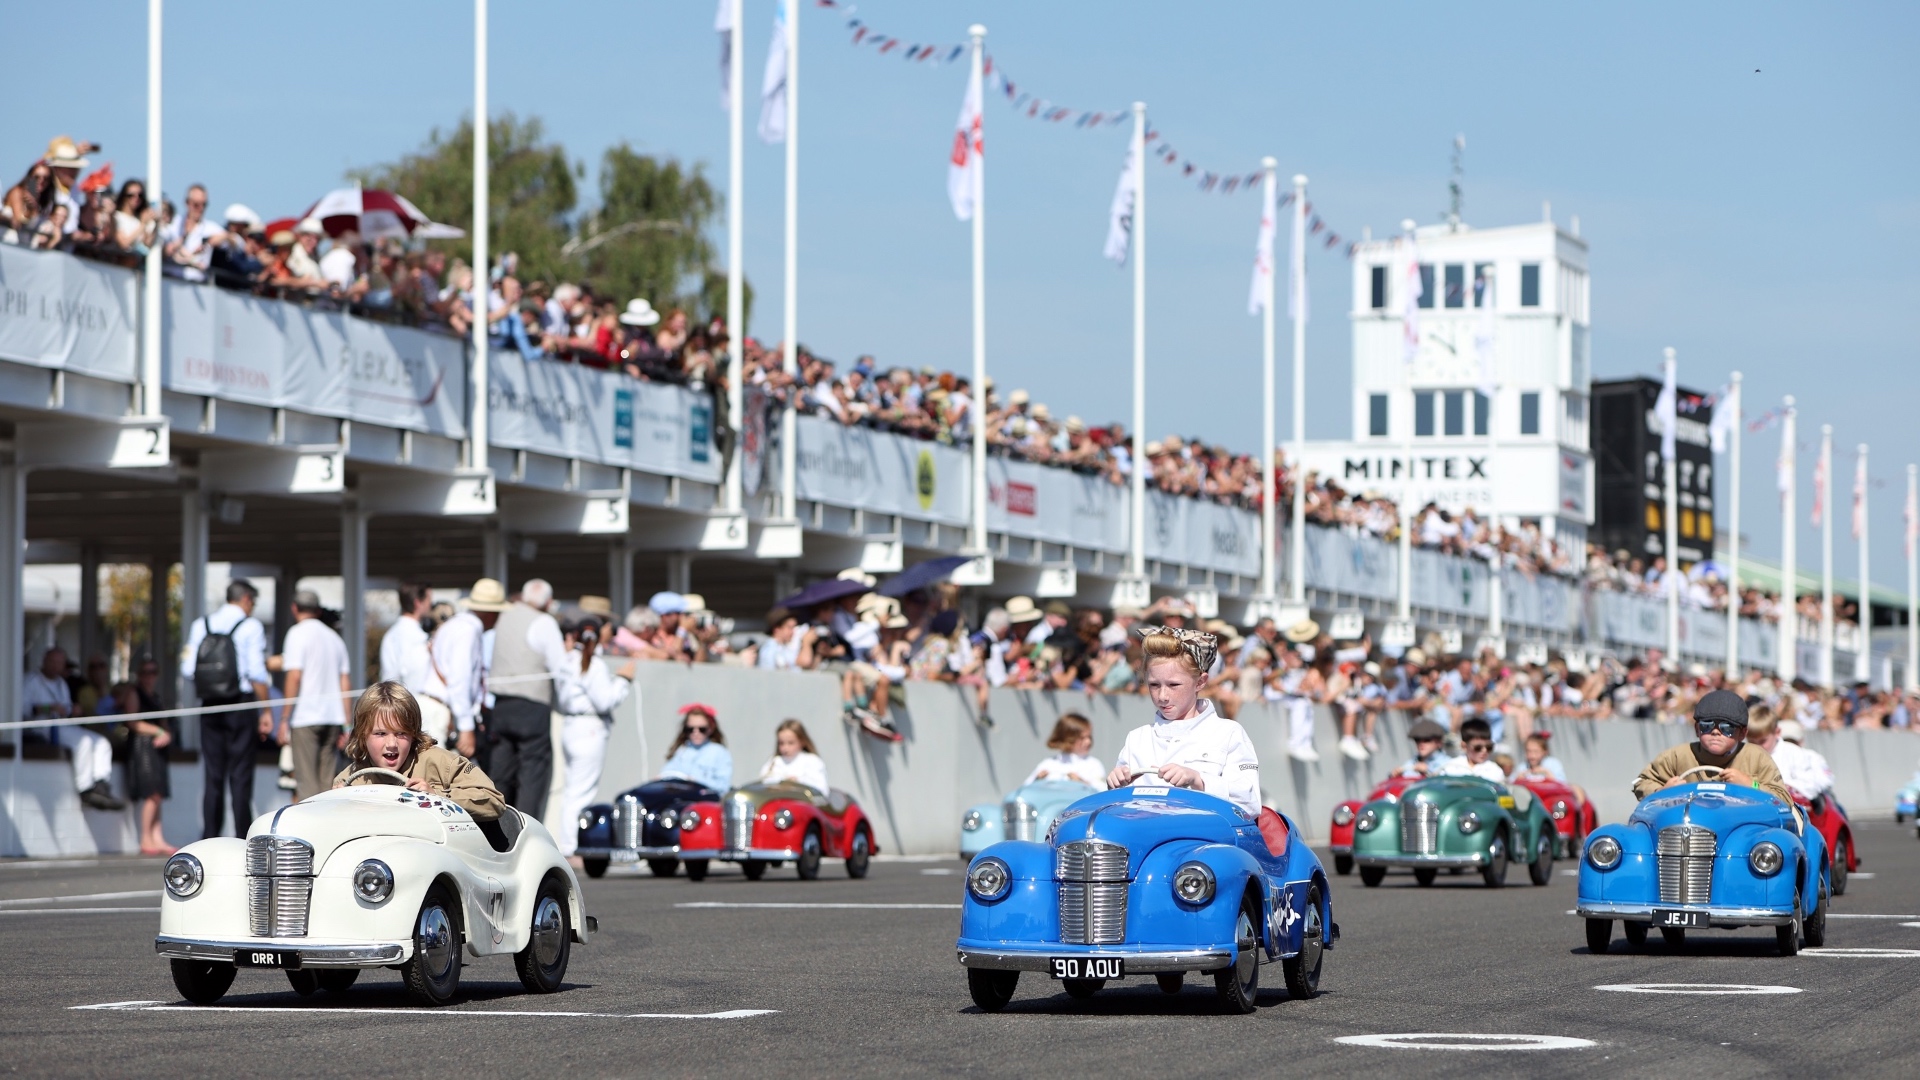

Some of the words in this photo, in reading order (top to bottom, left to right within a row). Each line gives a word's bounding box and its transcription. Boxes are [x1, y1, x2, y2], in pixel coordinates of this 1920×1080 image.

[146, 427, 161, 455] 2
[321, 455, 334, 482] 3
[1344, 456, 1486, 480] MINTEX
[473, 478, 486, 502] 4
[609, 498, 620, 522] 5
[726, 516, 740, 540] 6
[882, 540, 895, 562] 7
[1664, 912, 1689, 925] JEJ
[251, 952, 274, 965] ORR
[1055, 959, 1079, 978] 90
[1085, 959, 1120, 978] AOU
